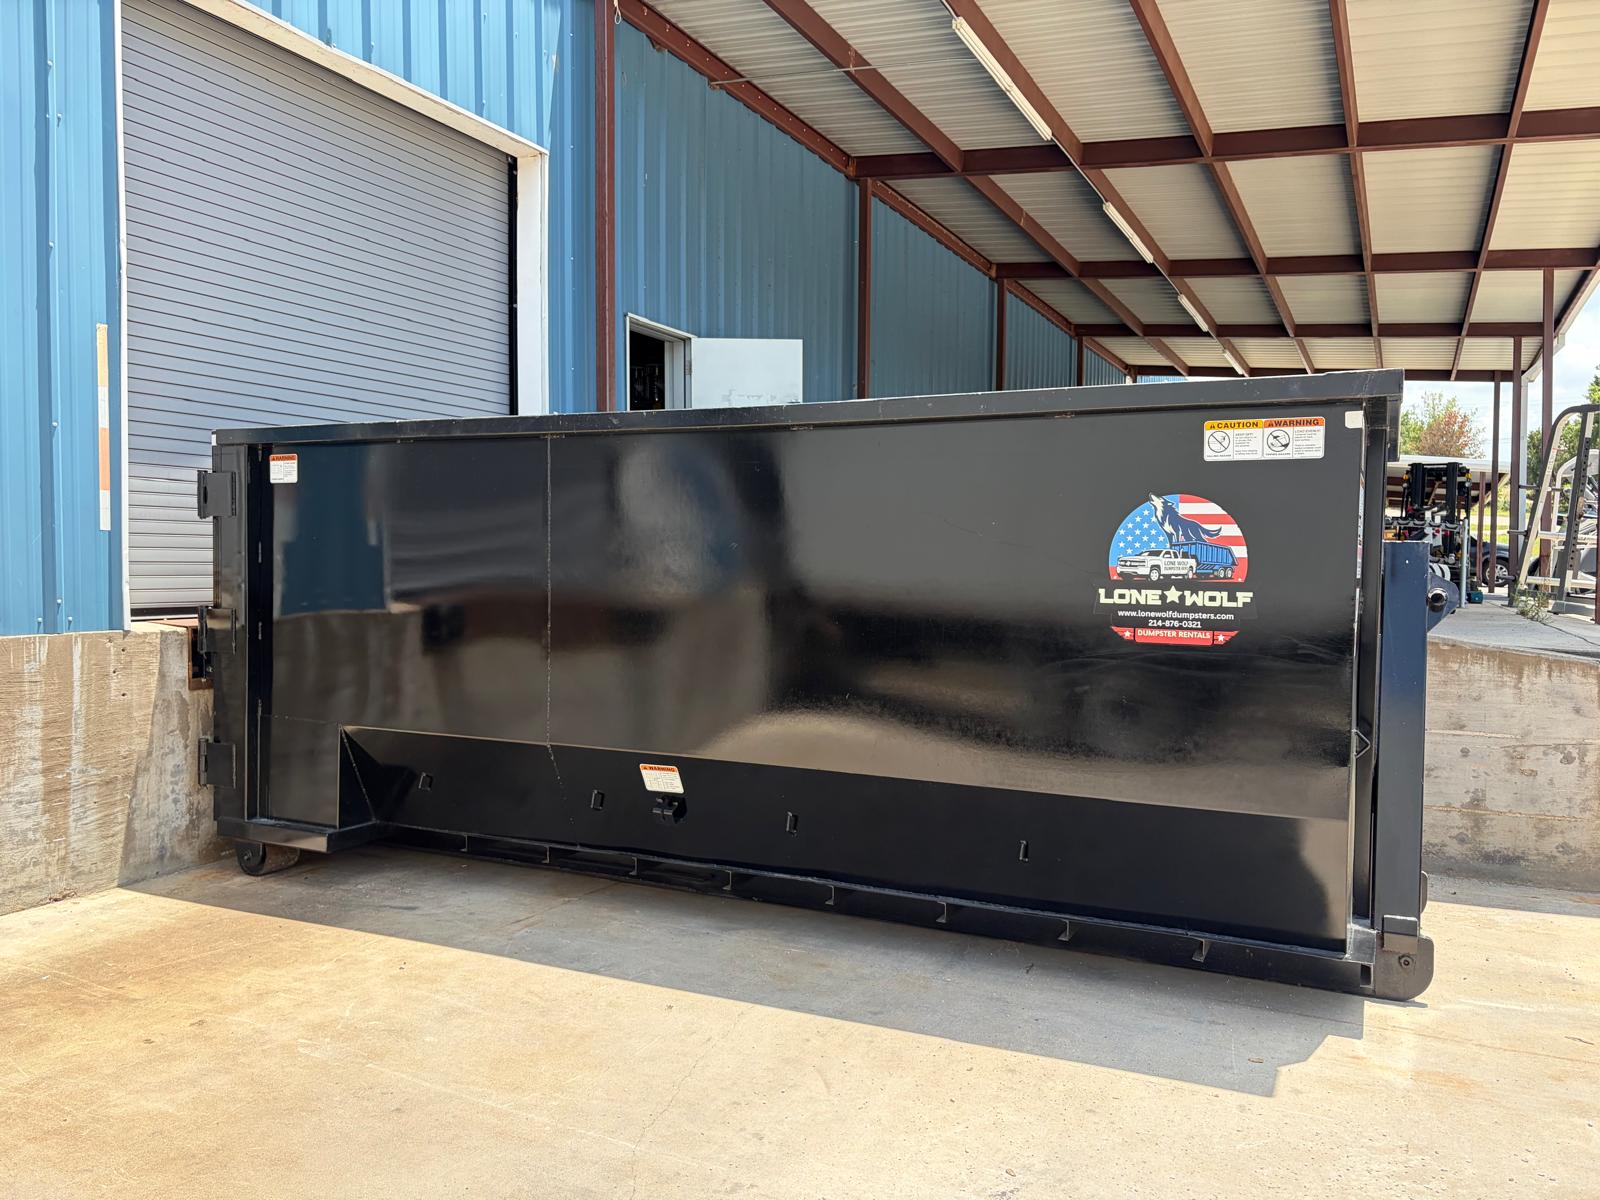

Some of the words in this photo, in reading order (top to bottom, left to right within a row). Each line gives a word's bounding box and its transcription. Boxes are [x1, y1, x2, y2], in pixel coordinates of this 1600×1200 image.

[1217, 421, 1259, 429] CAUTION
[1273, 418, 1319, 427] WARNING
[1098, 588, 1162, 605] LONE
[1184, 590, 1254, 607] WOLF
[1117, 609, 1235, 620] www.lonewolfdumpsters.com
[1148, 619, 1202, 628] 214-876-0321
[1137, 629, 1177, 638] DUMPSTER
[1178, 630, 1211, 639] RENTALS
